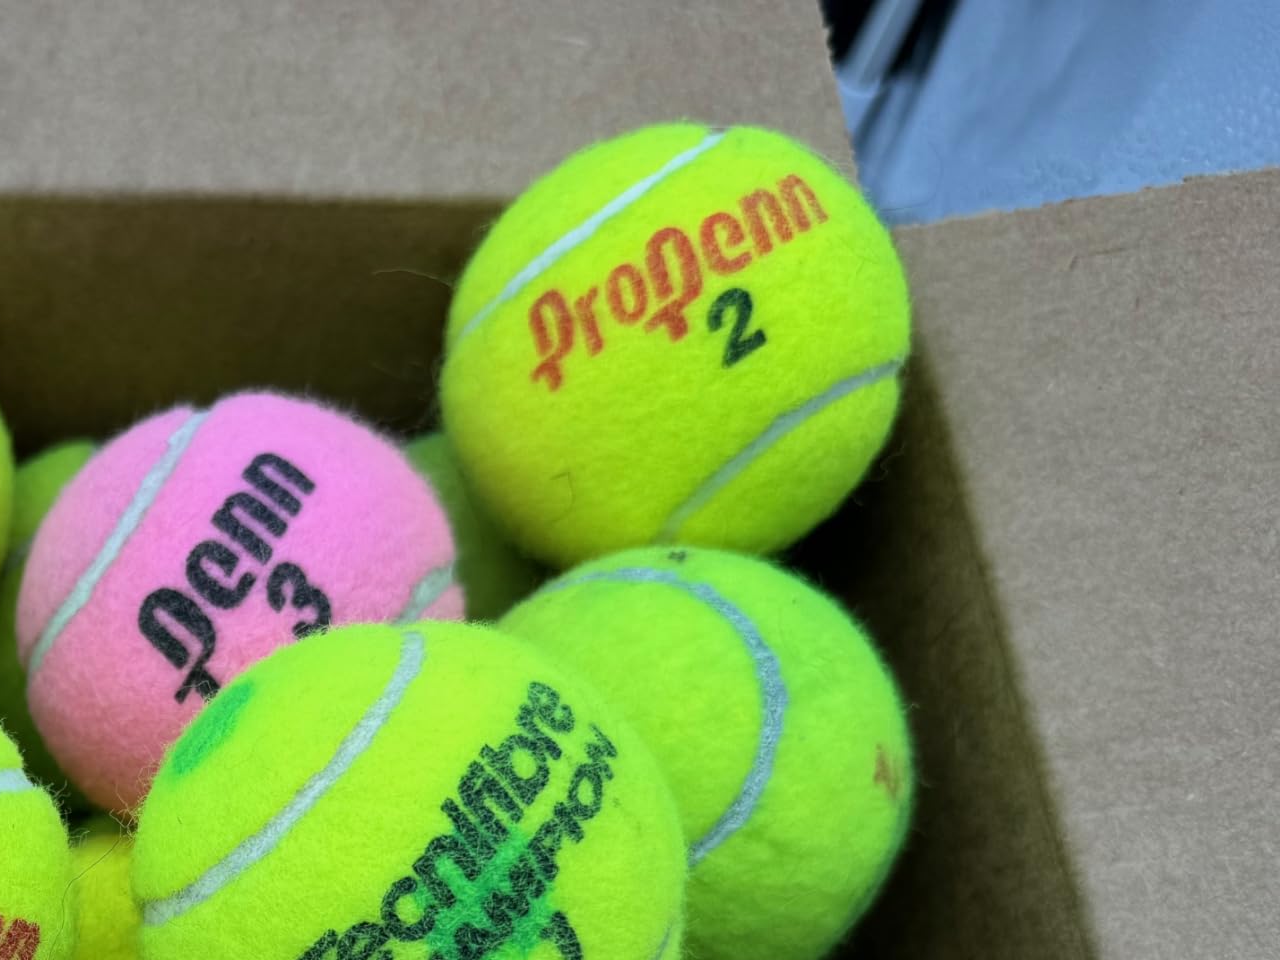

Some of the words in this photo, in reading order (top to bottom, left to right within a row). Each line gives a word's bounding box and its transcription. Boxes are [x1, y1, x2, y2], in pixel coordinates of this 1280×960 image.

[528, 174, 827, 392] ProPenn
[706, 287, 768, 369] 2
[138, 452, 316, 704] Penn
[266, 561, 332, 639] 3
